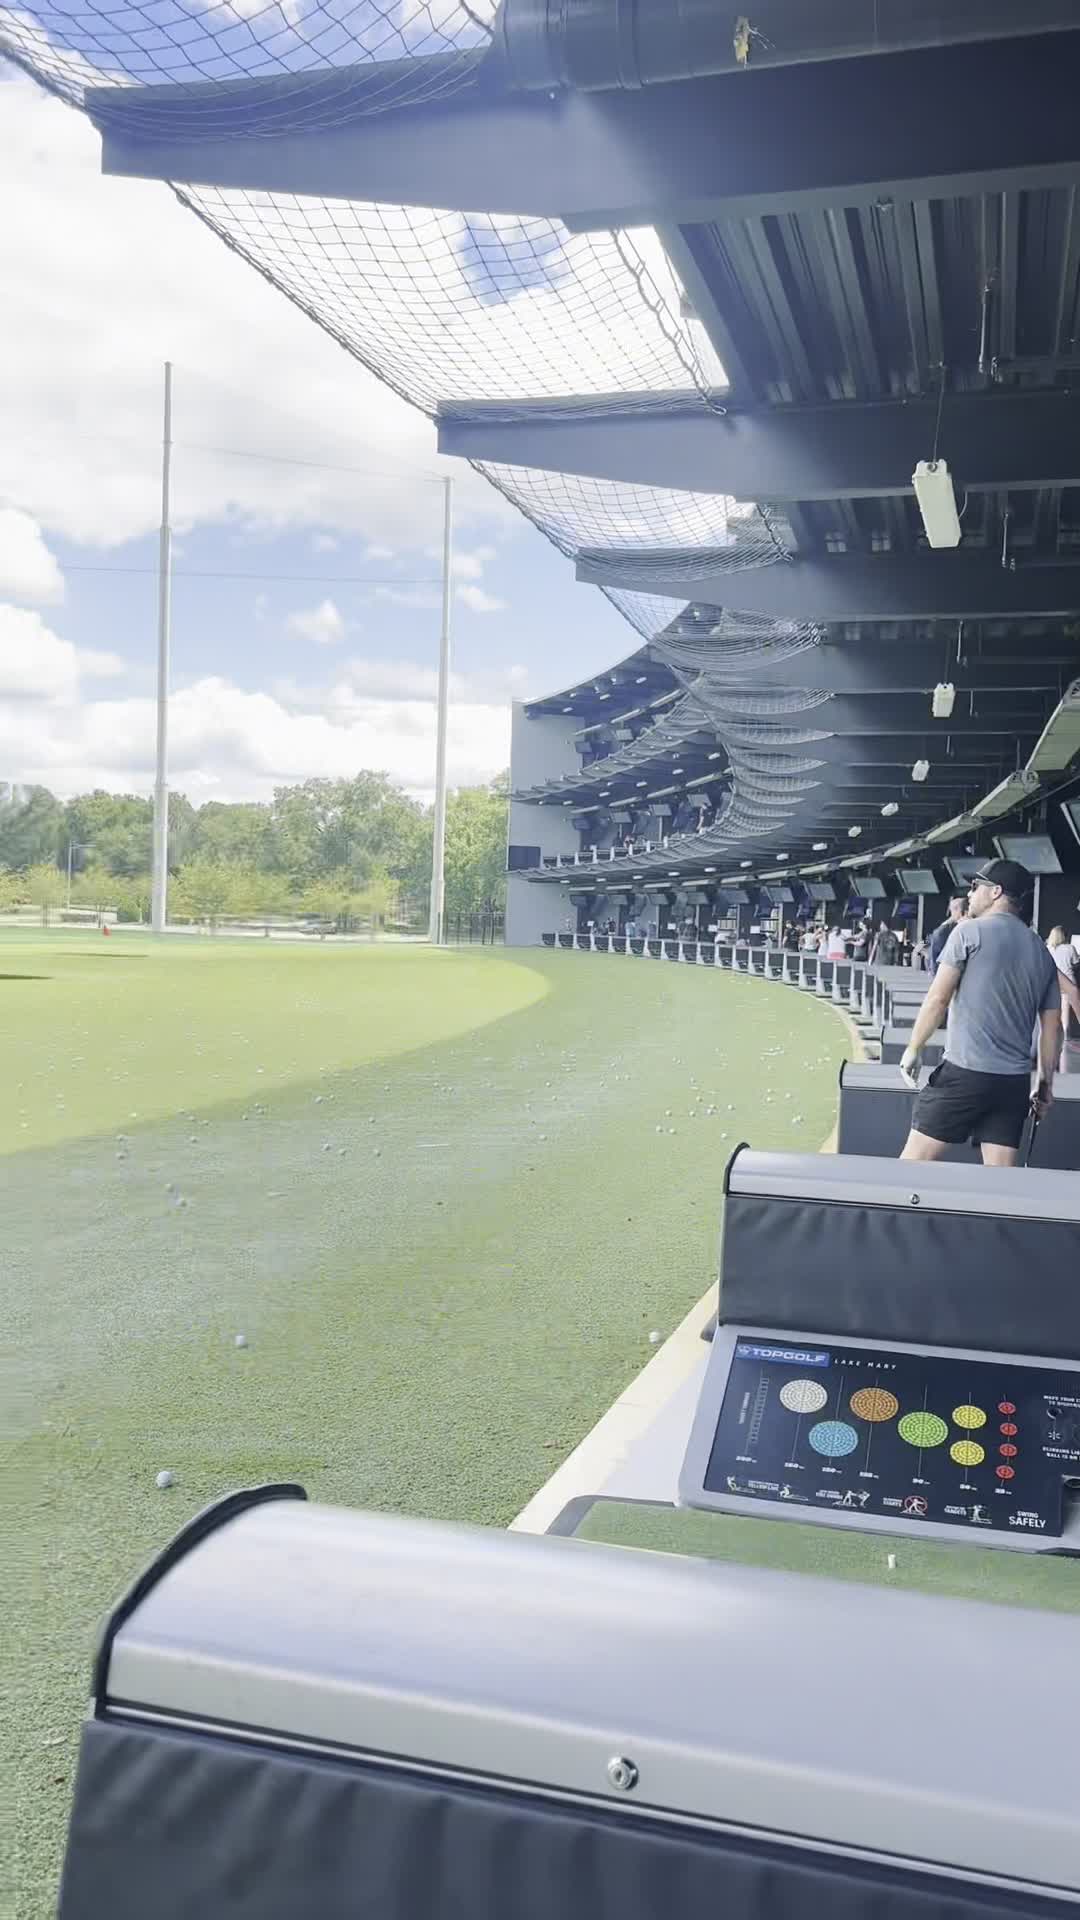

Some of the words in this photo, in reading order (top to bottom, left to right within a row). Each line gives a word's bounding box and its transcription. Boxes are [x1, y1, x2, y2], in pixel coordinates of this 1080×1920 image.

[752, 1349, 827, 1363] TOPGOLF
[834, 1359, 860, 1367] LAKE
[868, 1362, 896, 1370] MARY
[1017, 1510, 1039, 1519] SWING
[1008, 1516, 1046, 1528] SAFELY
